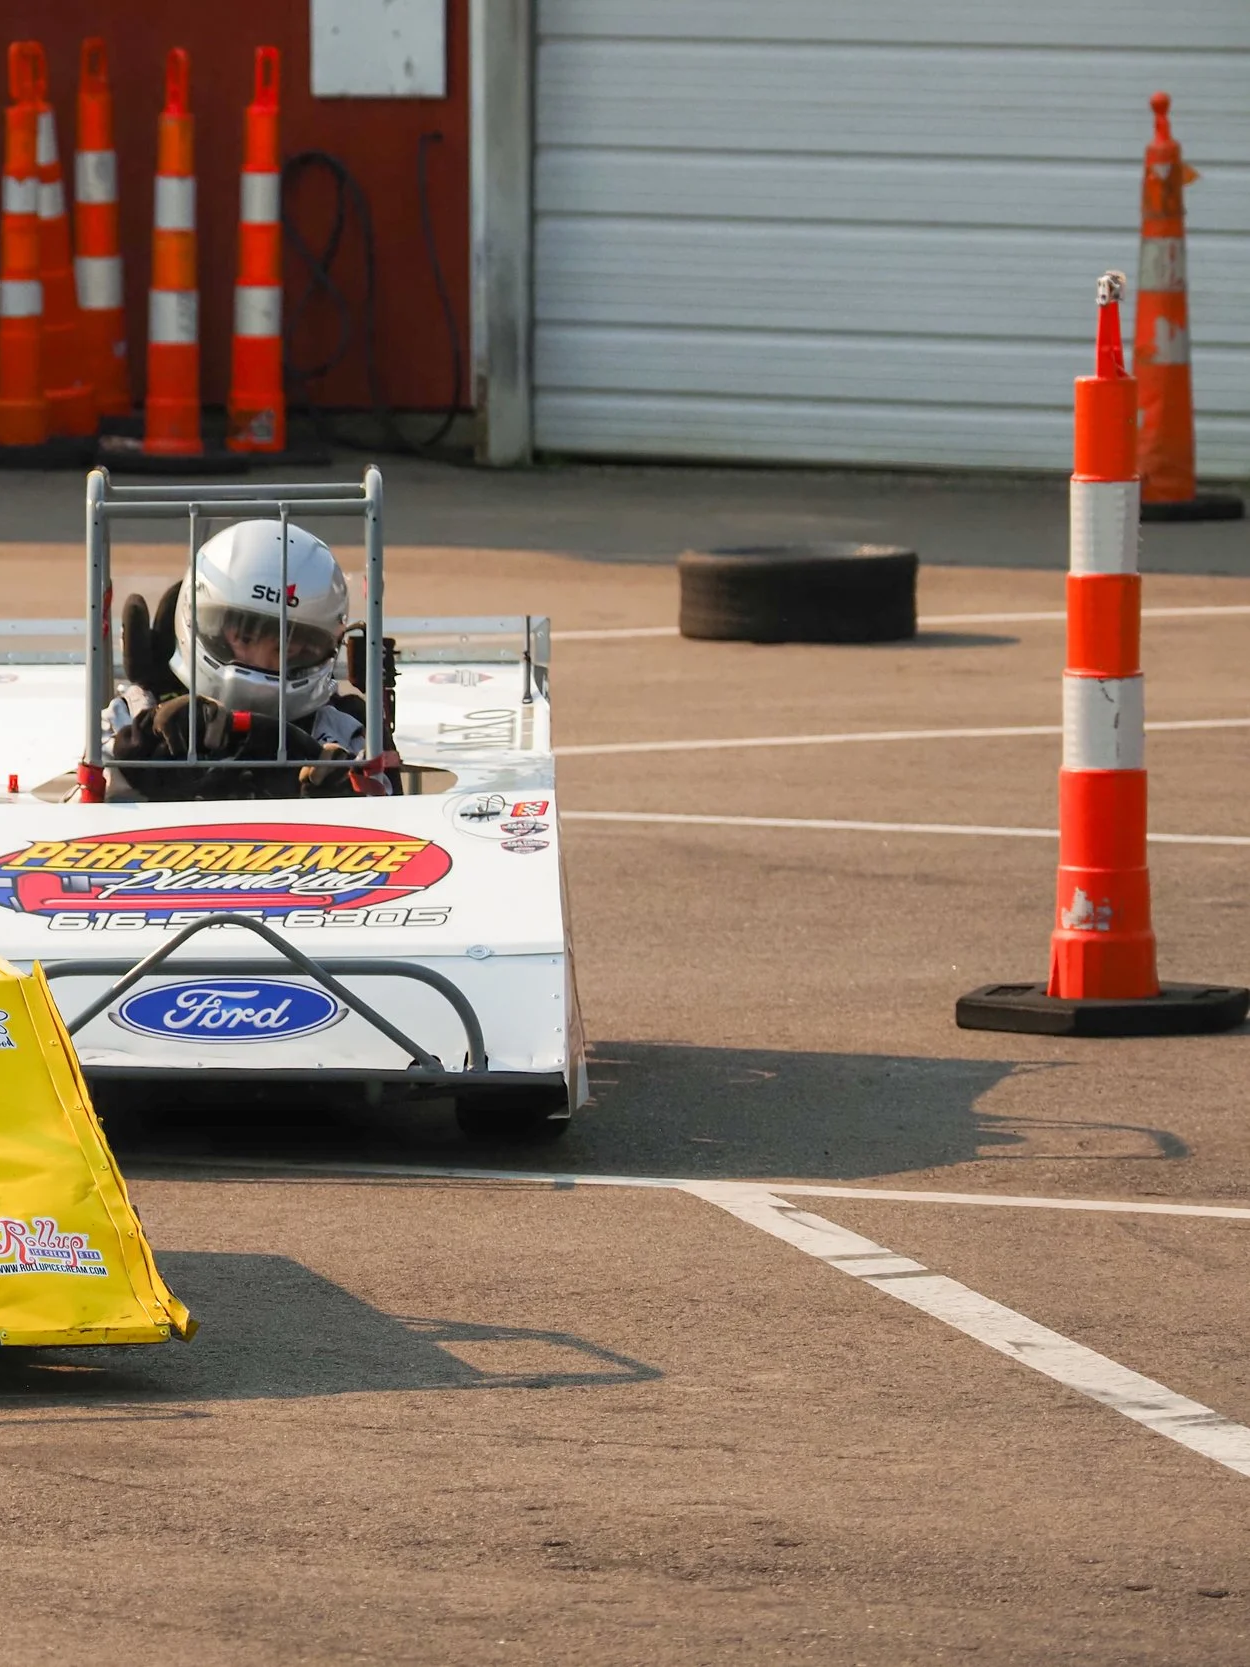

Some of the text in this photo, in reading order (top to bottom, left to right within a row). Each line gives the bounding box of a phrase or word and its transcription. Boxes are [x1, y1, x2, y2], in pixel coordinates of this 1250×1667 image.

[251, 584, 299, 608] Stio
[13, 840, 433, 873] PERFORMANCE
[99, 864, 426, 898] Plumbing
[162, 989, 293, 1030] Ford
